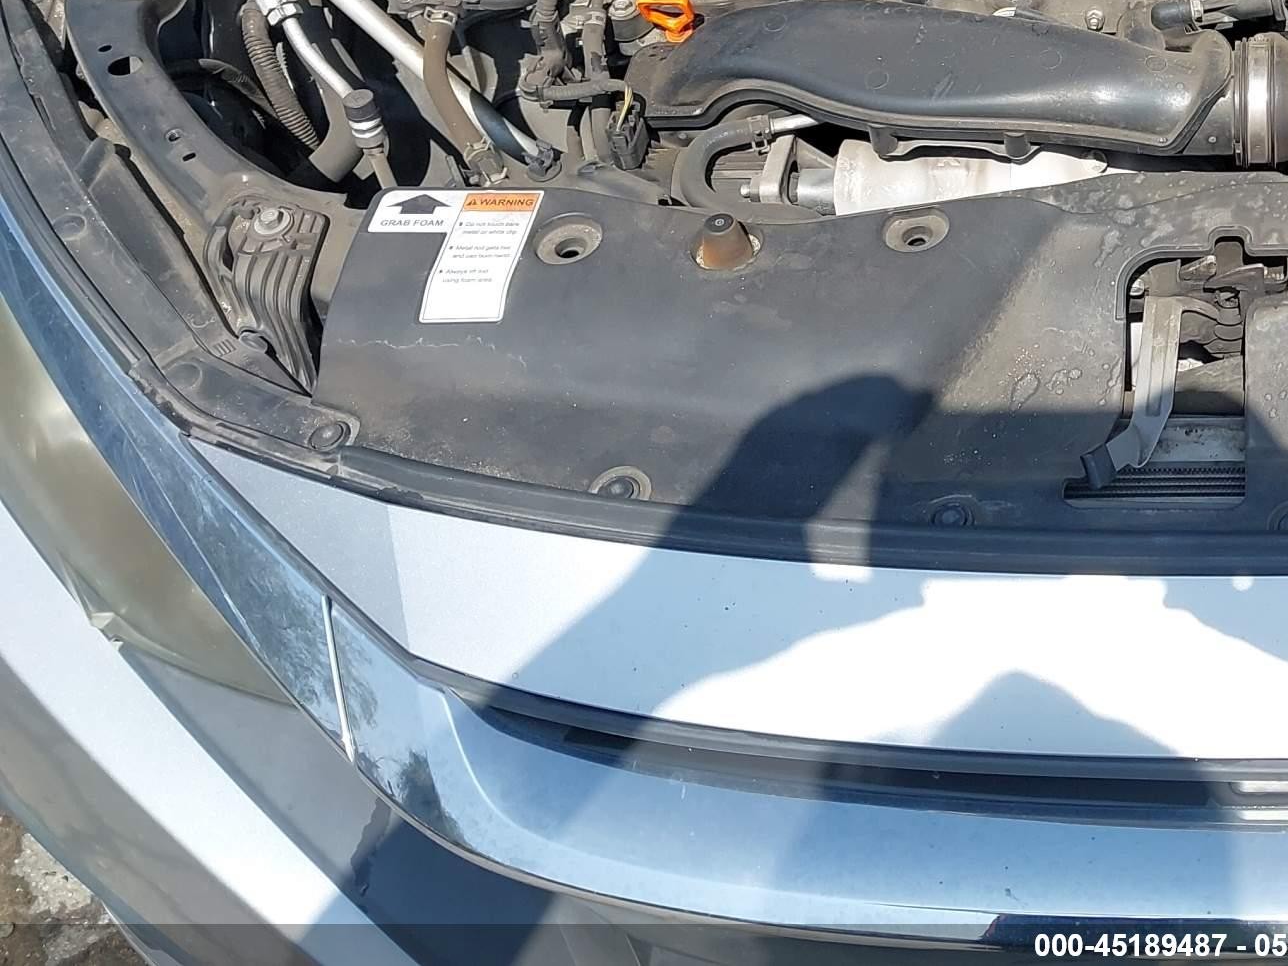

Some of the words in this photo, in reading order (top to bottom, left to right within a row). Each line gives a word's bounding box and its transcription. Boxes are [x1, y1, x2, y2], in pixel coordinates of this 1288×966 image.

[480, 198, 534, 207] WARNING
[380, 219, 410, 227] GRAB
[413, 219, 445, 227] FOAM
